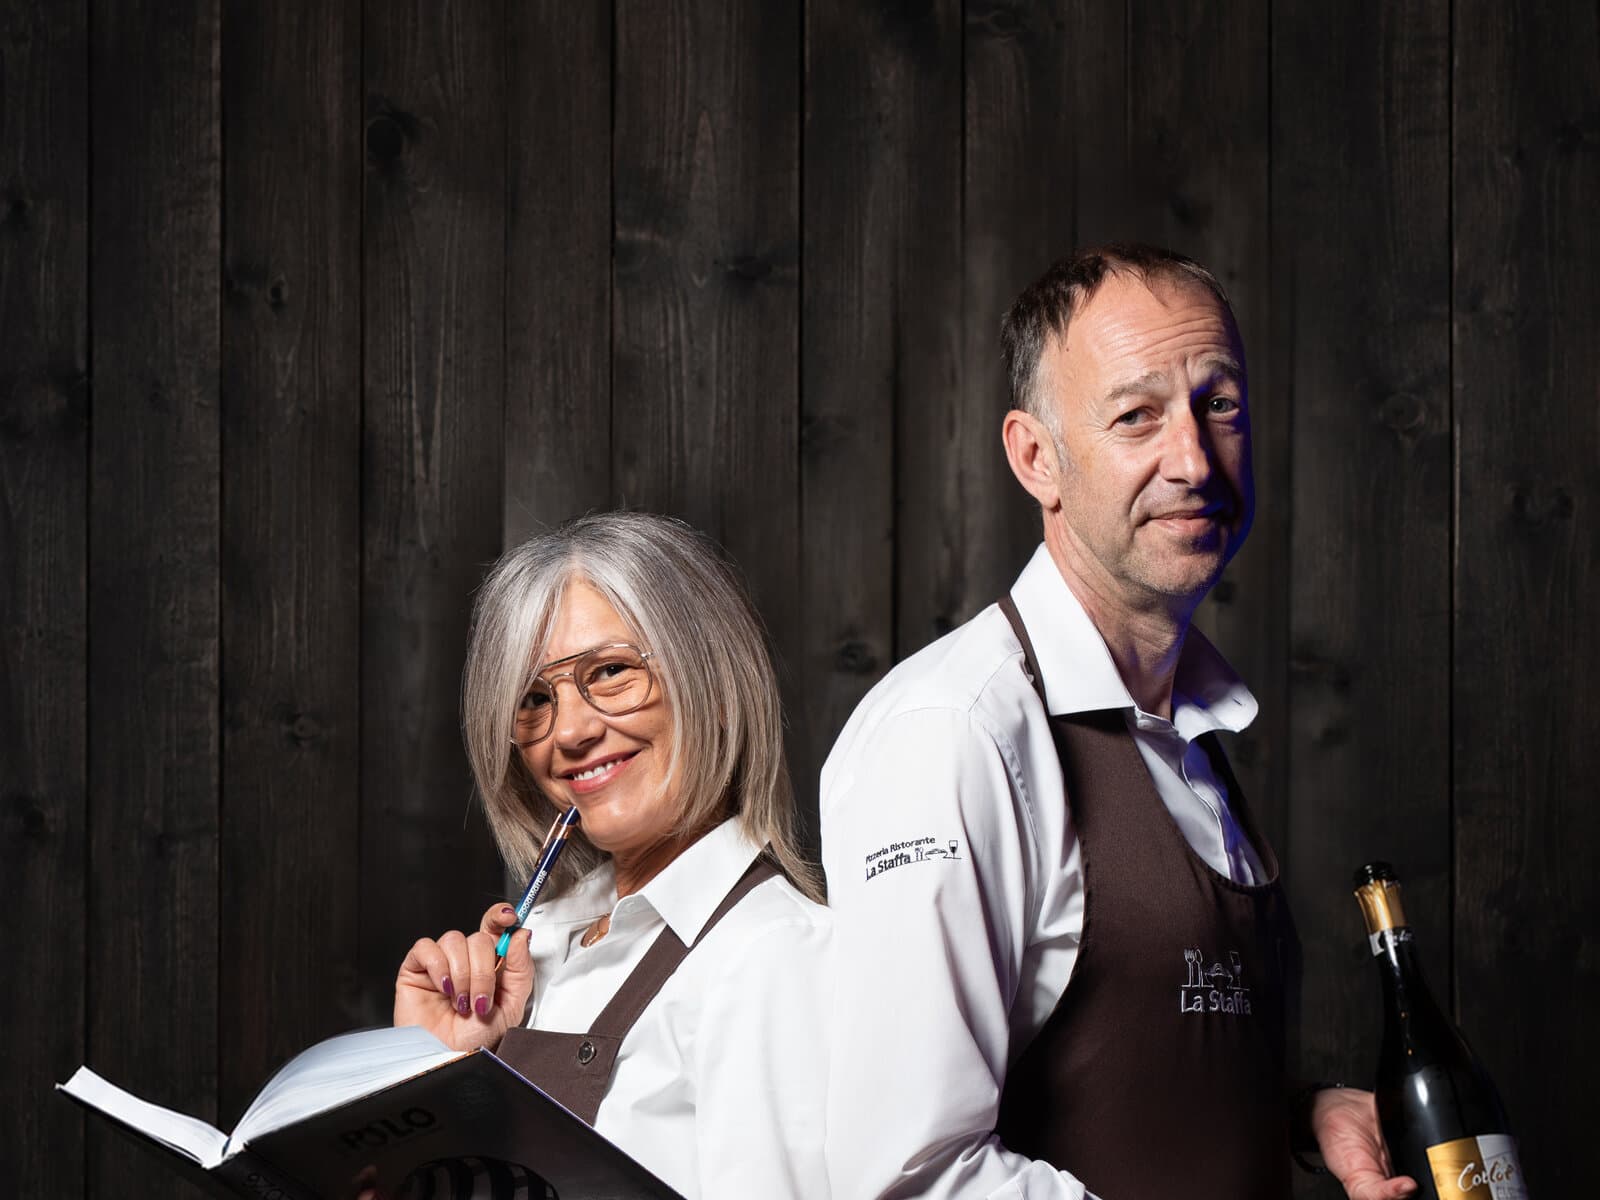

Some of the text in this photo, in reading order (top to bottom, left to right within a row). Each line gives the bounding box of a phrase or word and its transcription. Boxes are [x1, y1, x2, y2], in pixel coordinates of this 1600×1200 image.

[865, 836, 936, 864] Pizzeria Ristorante
[866, 852, 911, 881] La Staffa
[1181, 990, 1252, 1015] La Staffa
